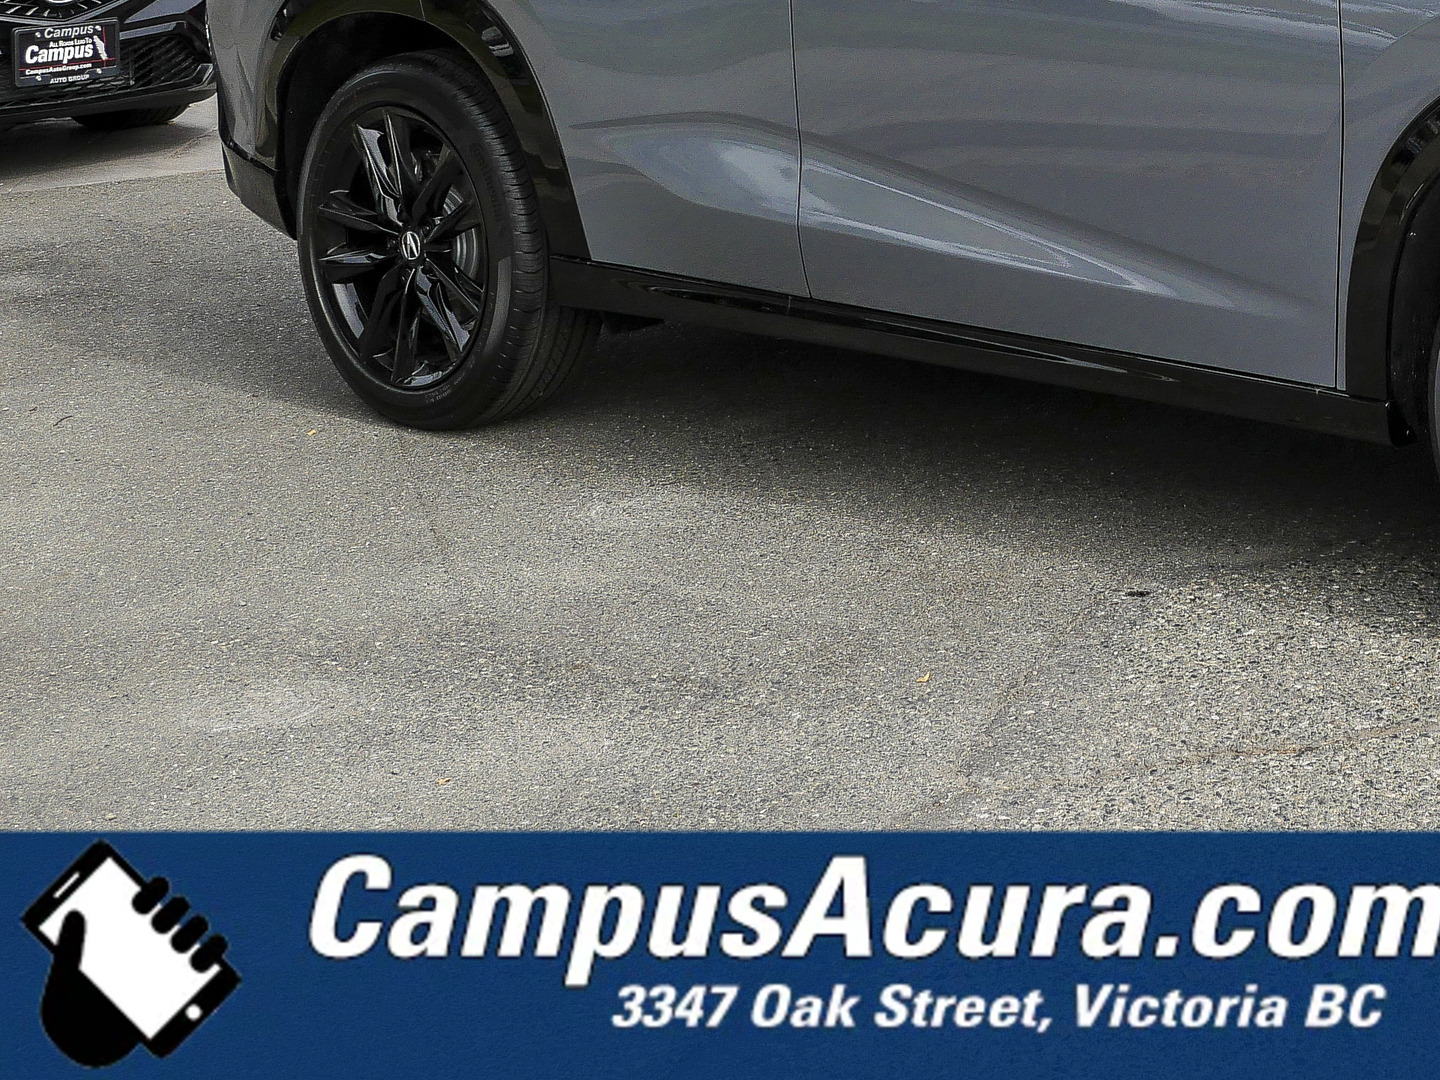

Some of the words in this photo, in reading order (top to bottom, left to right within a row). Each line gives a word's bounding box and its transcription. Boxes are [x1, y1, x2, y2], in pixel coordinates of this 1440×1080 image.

[44, 25, 94, 39] Campus
[25, 44, 94, 64] Campus
[50, 76, 67, 84] AUTO
